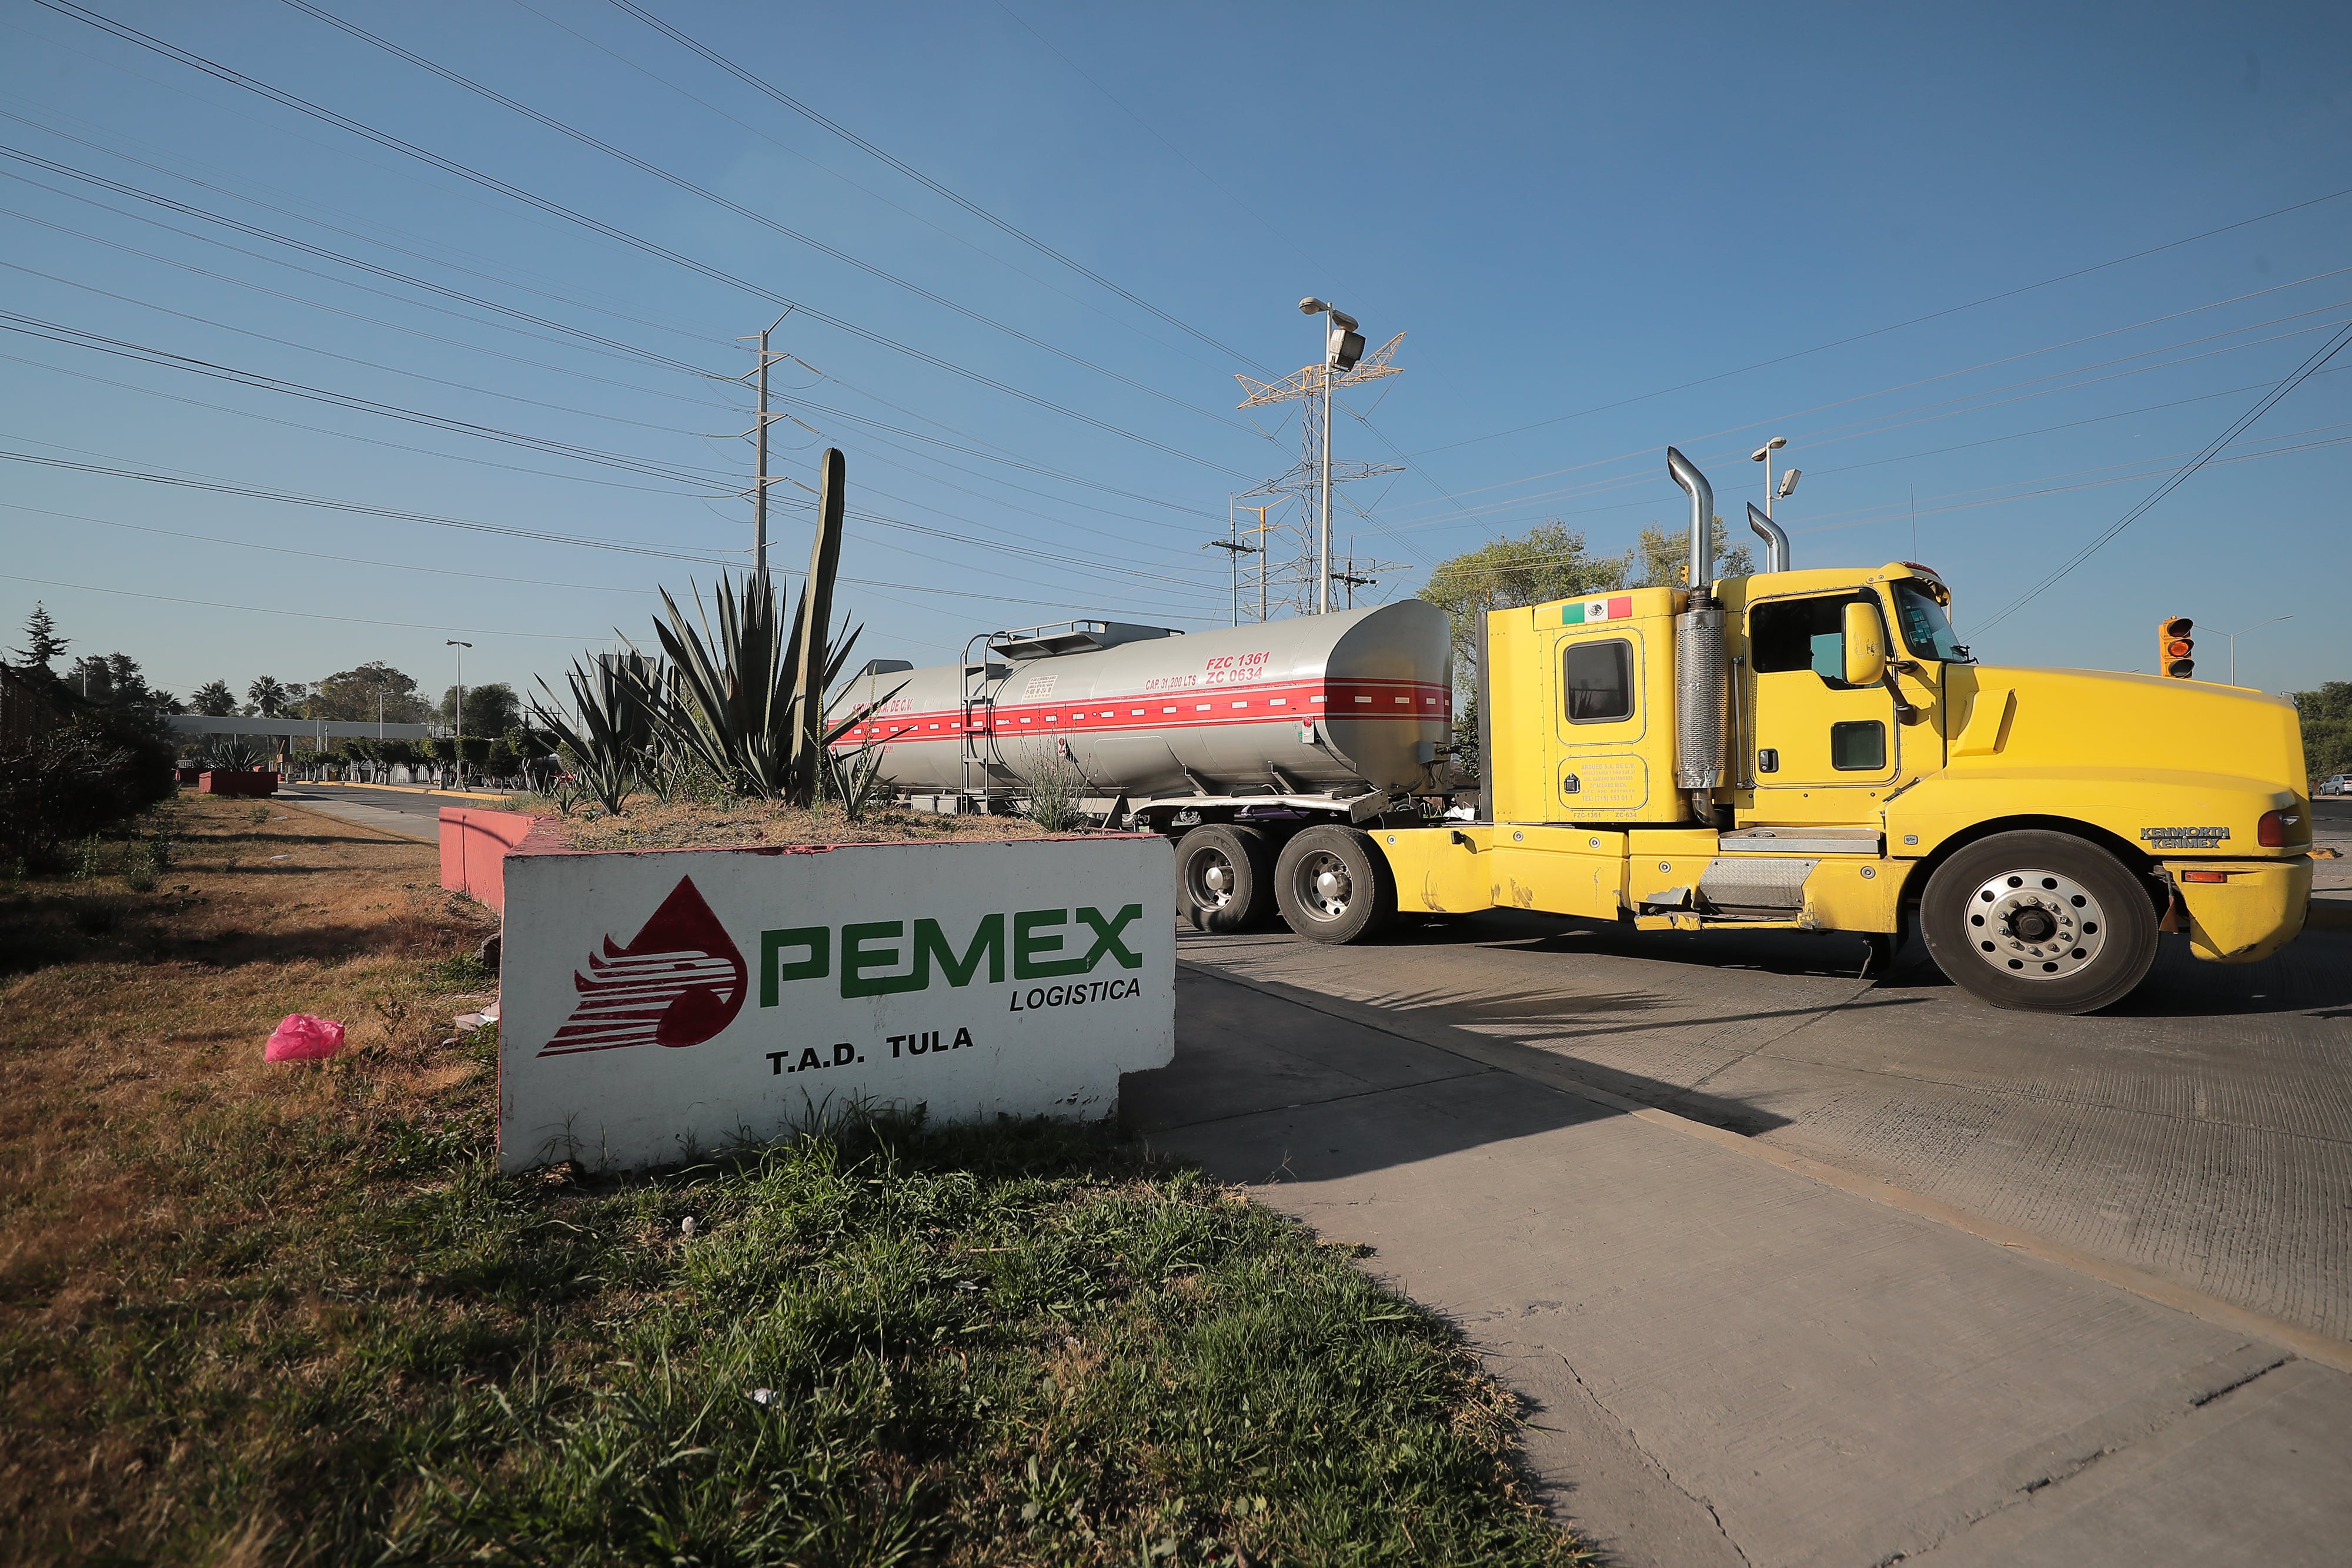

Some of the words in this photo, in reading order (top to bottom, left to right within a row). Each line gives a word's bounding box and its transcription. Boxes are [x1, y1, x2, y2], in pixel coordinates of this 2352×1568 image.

[1205, 656, 1234, 670] FZC
[1238, 651, 1270, 667] 1361
[1145, 678, 1160, 691] CAP.
[1161, 676, 1182, 691] 31,200
[1183, 674, 1197, 687] LTS
[1205, 671, 1225, 685] ZC
[1229, 666, 1263, 683] 0634
[890, 699, 900, 712] DE
[900, 698, 913, 711] C.V.
[2141, 827, 2230, 837] KENWORTH
[2152, 838, 2220, 848] KENMEX
[760, 903, 1143, 1008] PEMEX
[1009, 978, 1141, 1012] LOGISTICA
[766, 1042, 865, 1075] T.A.D.
[886, 1027, 974, 1058] TULA
